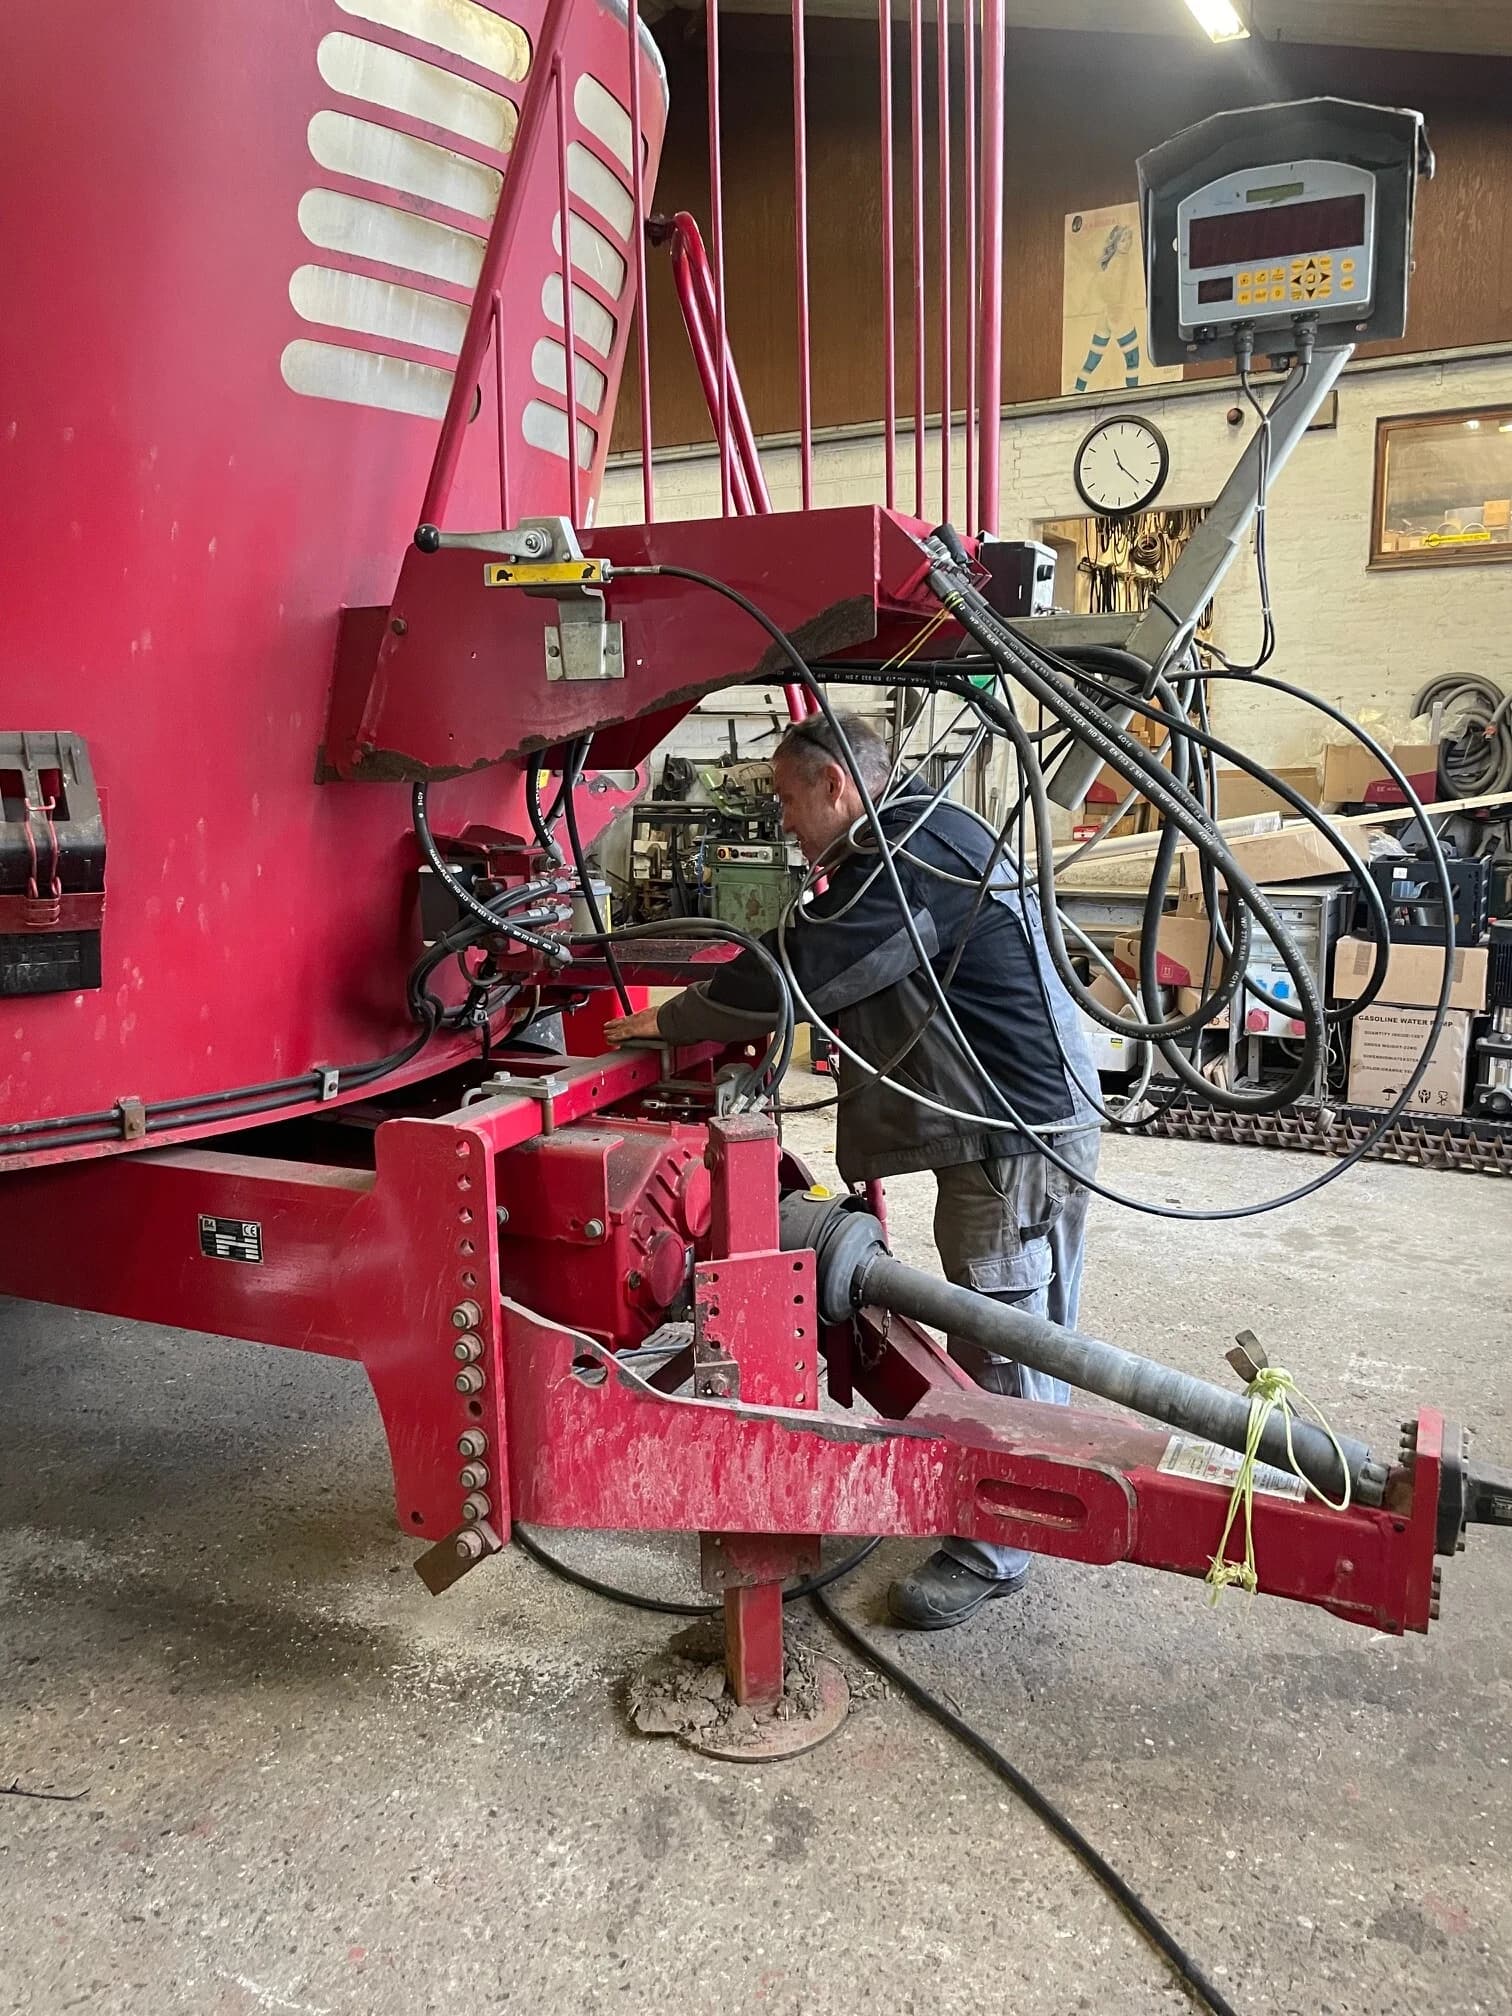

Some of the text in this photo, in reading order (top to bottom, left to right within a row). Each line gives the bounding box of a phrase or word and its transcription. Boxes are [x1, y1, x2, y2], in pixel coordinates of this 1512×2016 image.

[986, 633, 998, 646] BAR
[1087, 728, 1096, 737] HD
[1109, 747, 1118, 756] EN
[1158, 792, 1169, 803] WP
[429, 848, 452, 883] HANSA-FLEX
[452, 884, 461, 893] HD
[459, 892, 469, 901] 213
[469, 901, 478, 910] EN
[1240, 916, 1247, 928] WP
[1358, 1015, 1398, 1024] GASOLINE
[1400, 1018, 1428, 1026] WATER
